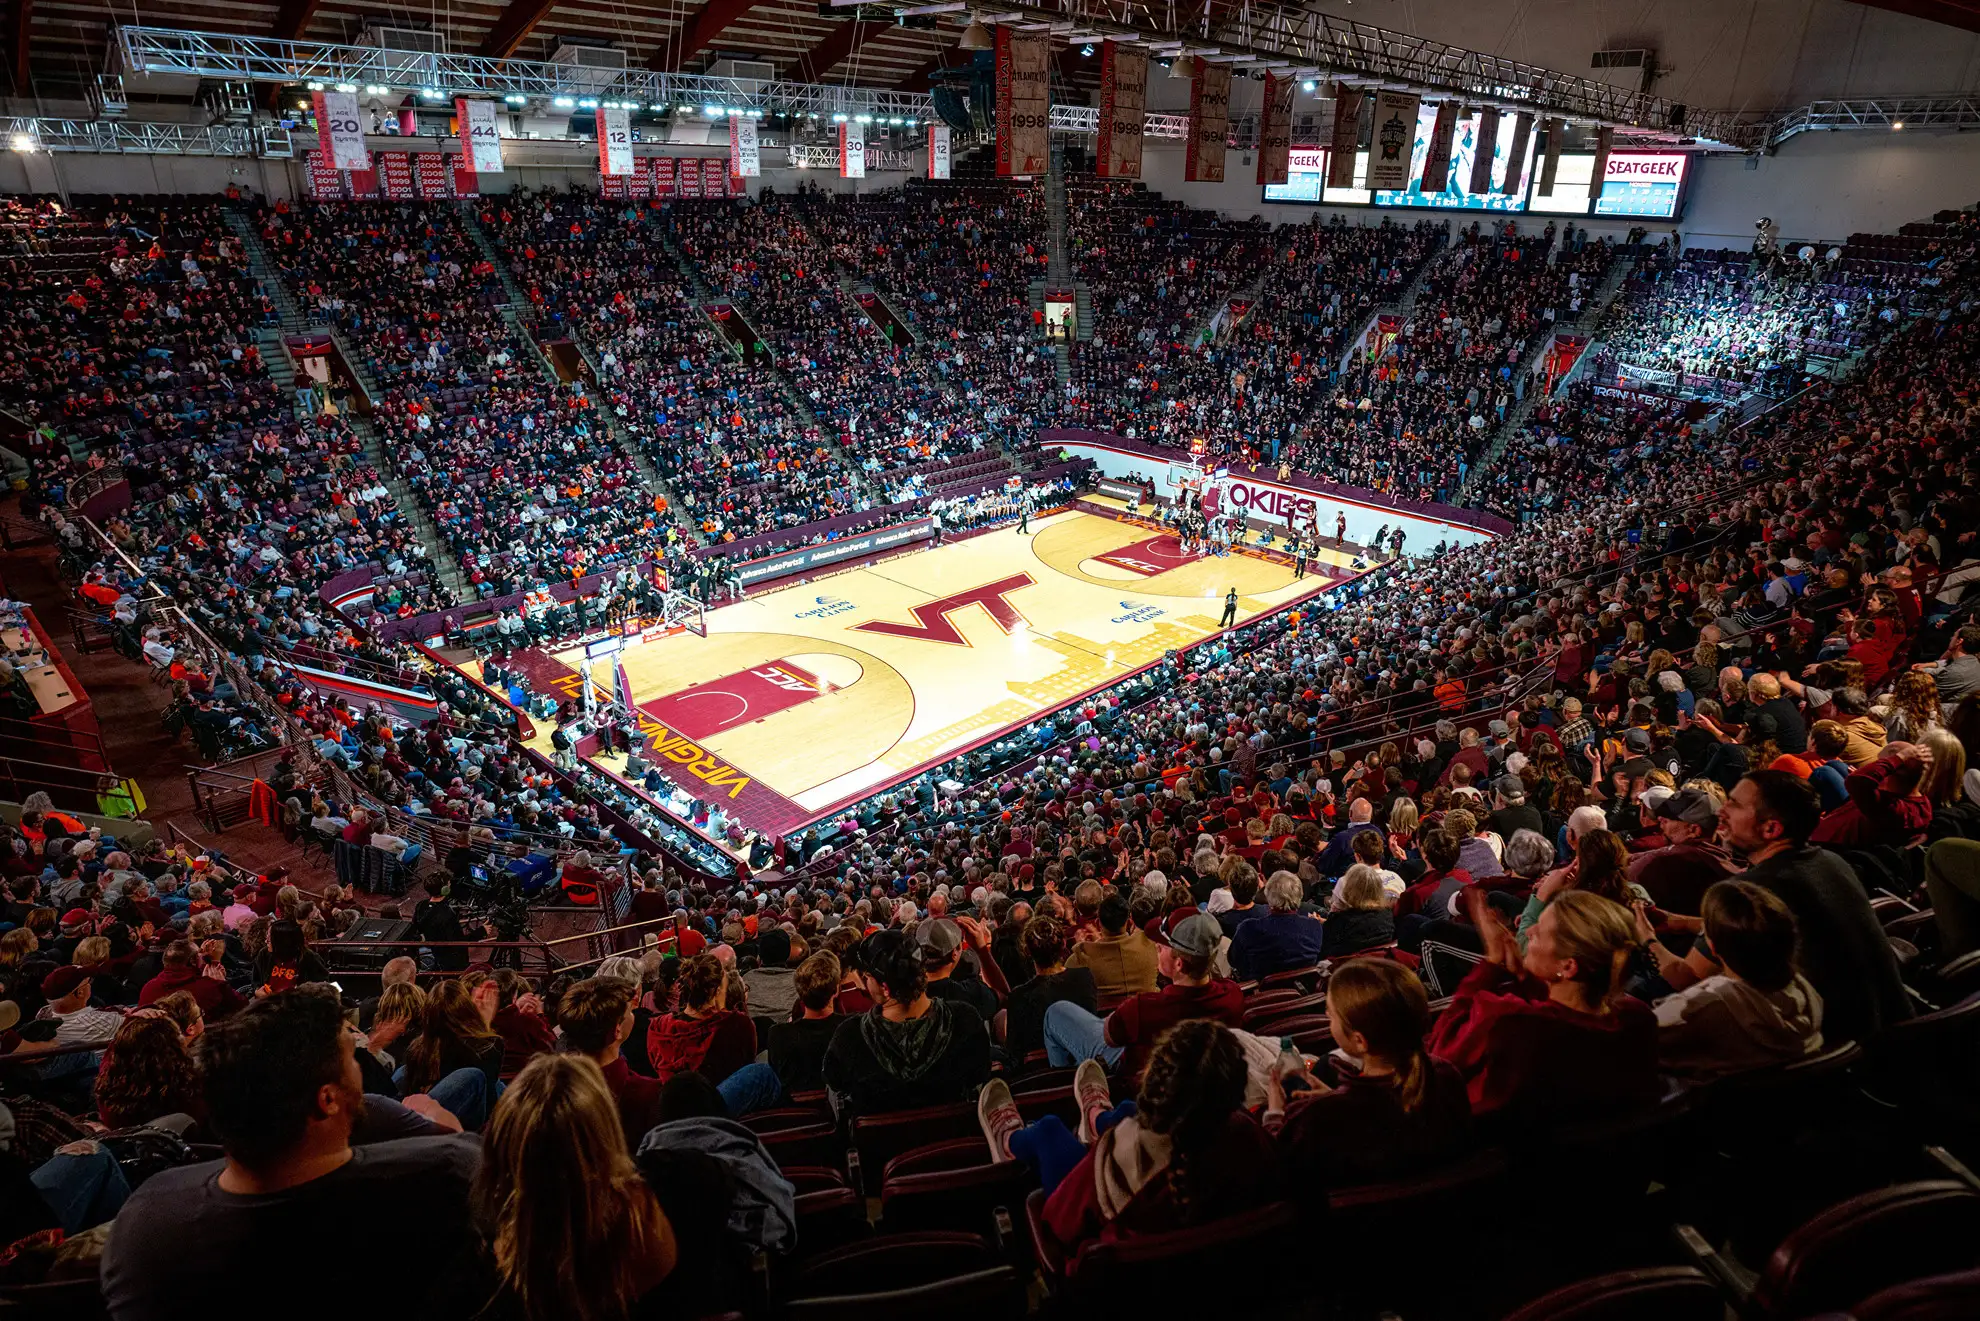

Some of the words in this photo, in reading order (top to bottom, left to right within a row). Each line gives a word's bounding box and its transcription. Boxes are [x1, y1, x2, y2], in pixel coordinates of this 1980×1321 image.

[1001, 41, 1009, 163] BASKETBALL
[330, 119, 359, 133] 20
[1011, 115, 1046, 128] 1998
[471, 126, 496, 137] 44
[1113, 121, 1142, 136] 1999
[610, 132, 626, 143] 12
[1201, 131, 1225, 143] 1994
[847, 142, 863, 151] 30
[937, 145, 947, 154] 12
[1289, 155, 1320, 167] TGEEK
[1607, 160, 1679, 176] SEATGEEK
[1229, 484, 1317, 521] OKIES
[876, 534, 898, 546] Advance
[811, 550, 836, 562] Advance
[836, 547, 850, 555] Auto
[1104, 556, 1166, 572] ACC
[740, 568, 767, 580] Advance
[767, 564, 783, 573] Auto
[750, 666, 819, 692] ACC
[522, 729, 534, 737] VT
